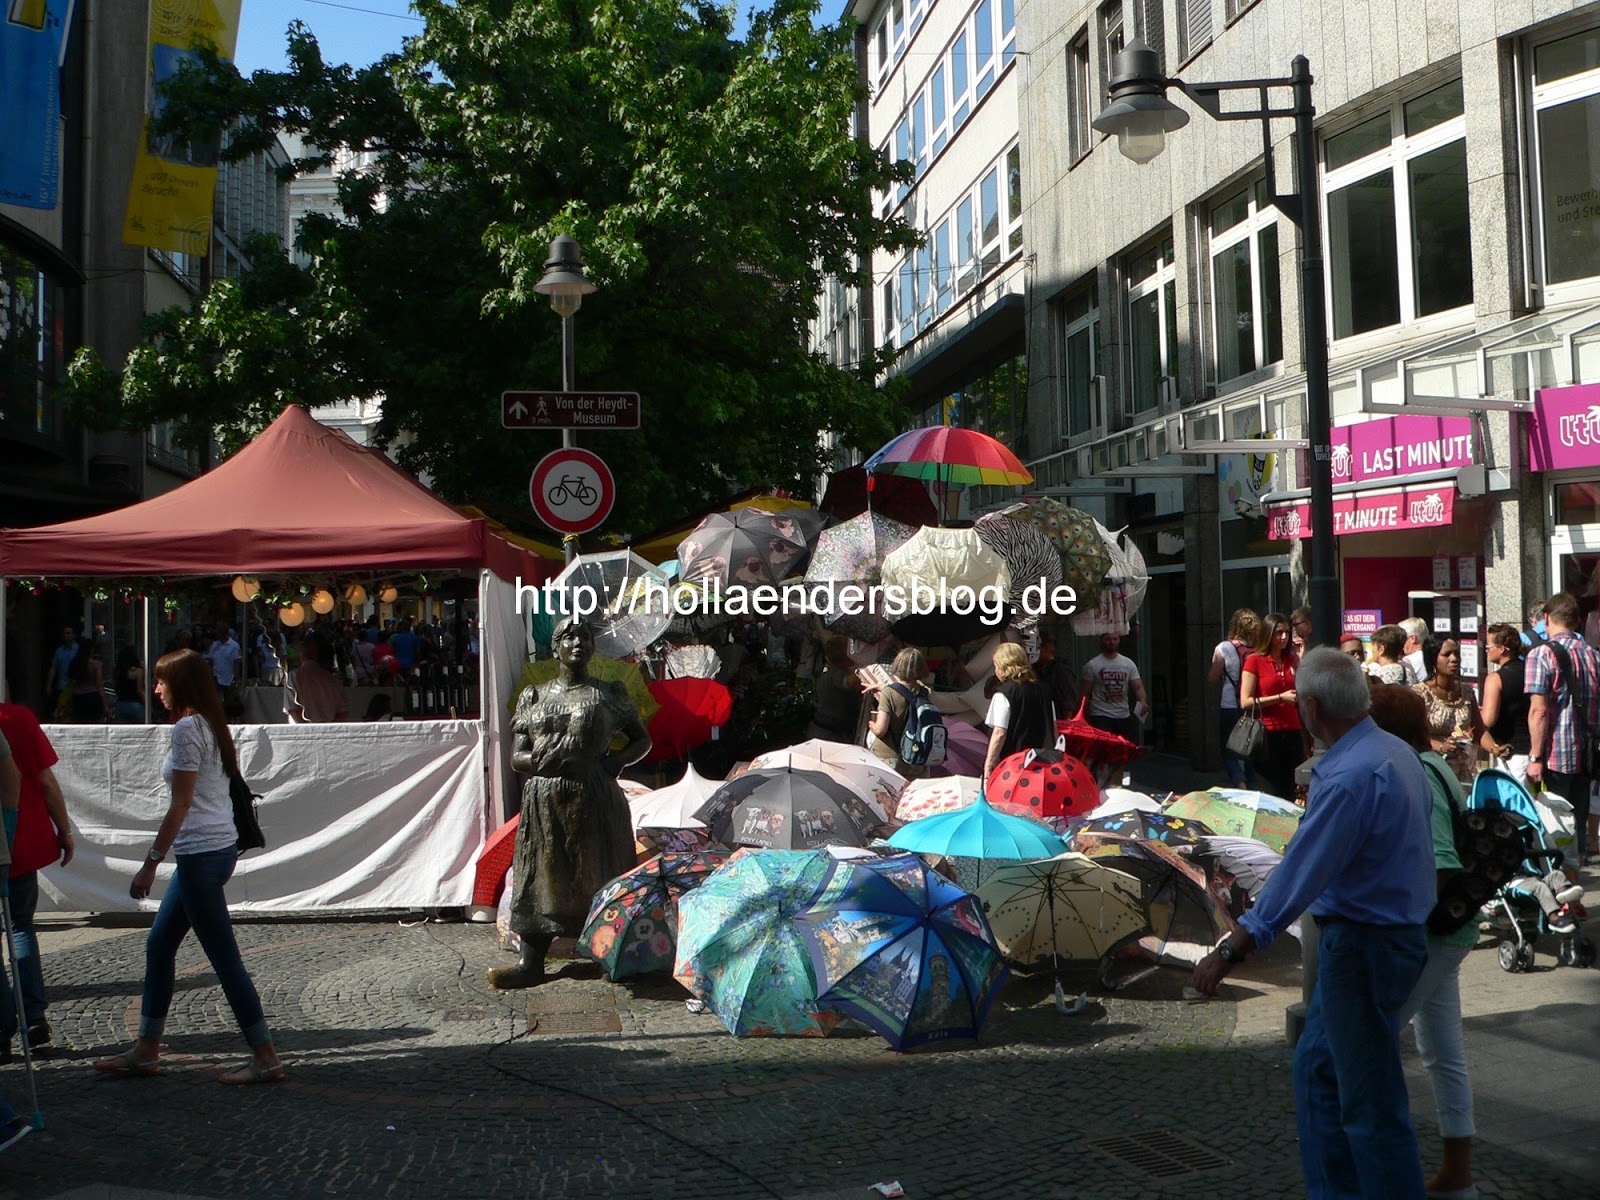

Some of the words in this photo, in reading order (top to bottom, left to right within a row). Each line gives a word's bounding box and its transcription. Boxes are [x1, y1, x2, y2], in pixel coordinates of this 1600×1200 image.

[1557, 187, 1600, 207] Bewerb
[1557, 207, 1580, 223] und
[555, 396, 574, 410] Von
[577, 396, 595, 410] der
[598, 396, 633, 413] Heydt-
[573, 411, 617, 424] Museum
[1363, 446, 1404, 474] LAST
[1344, 505, 1398, 531] MINUTE
